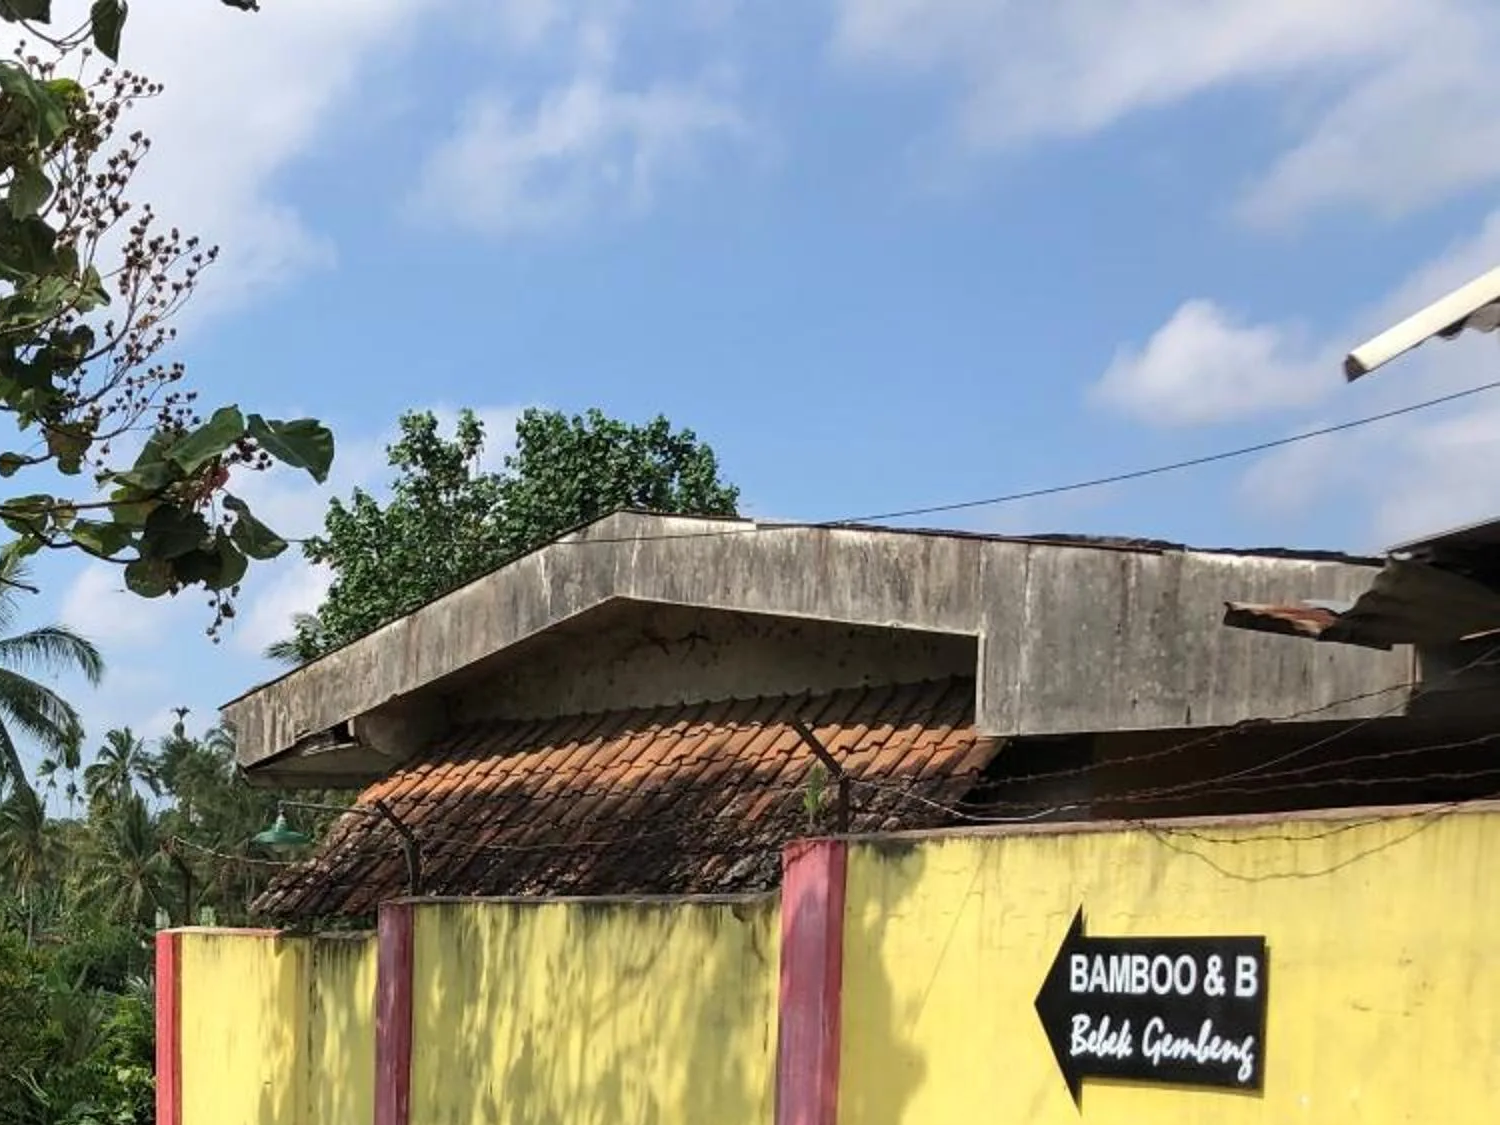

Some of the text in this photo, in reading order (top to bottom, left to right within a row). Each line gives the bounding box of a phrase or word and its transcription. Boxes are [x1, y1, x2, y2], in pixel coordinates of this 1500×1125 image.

[1070, 954, 1258, 997] BAMBOO & B
